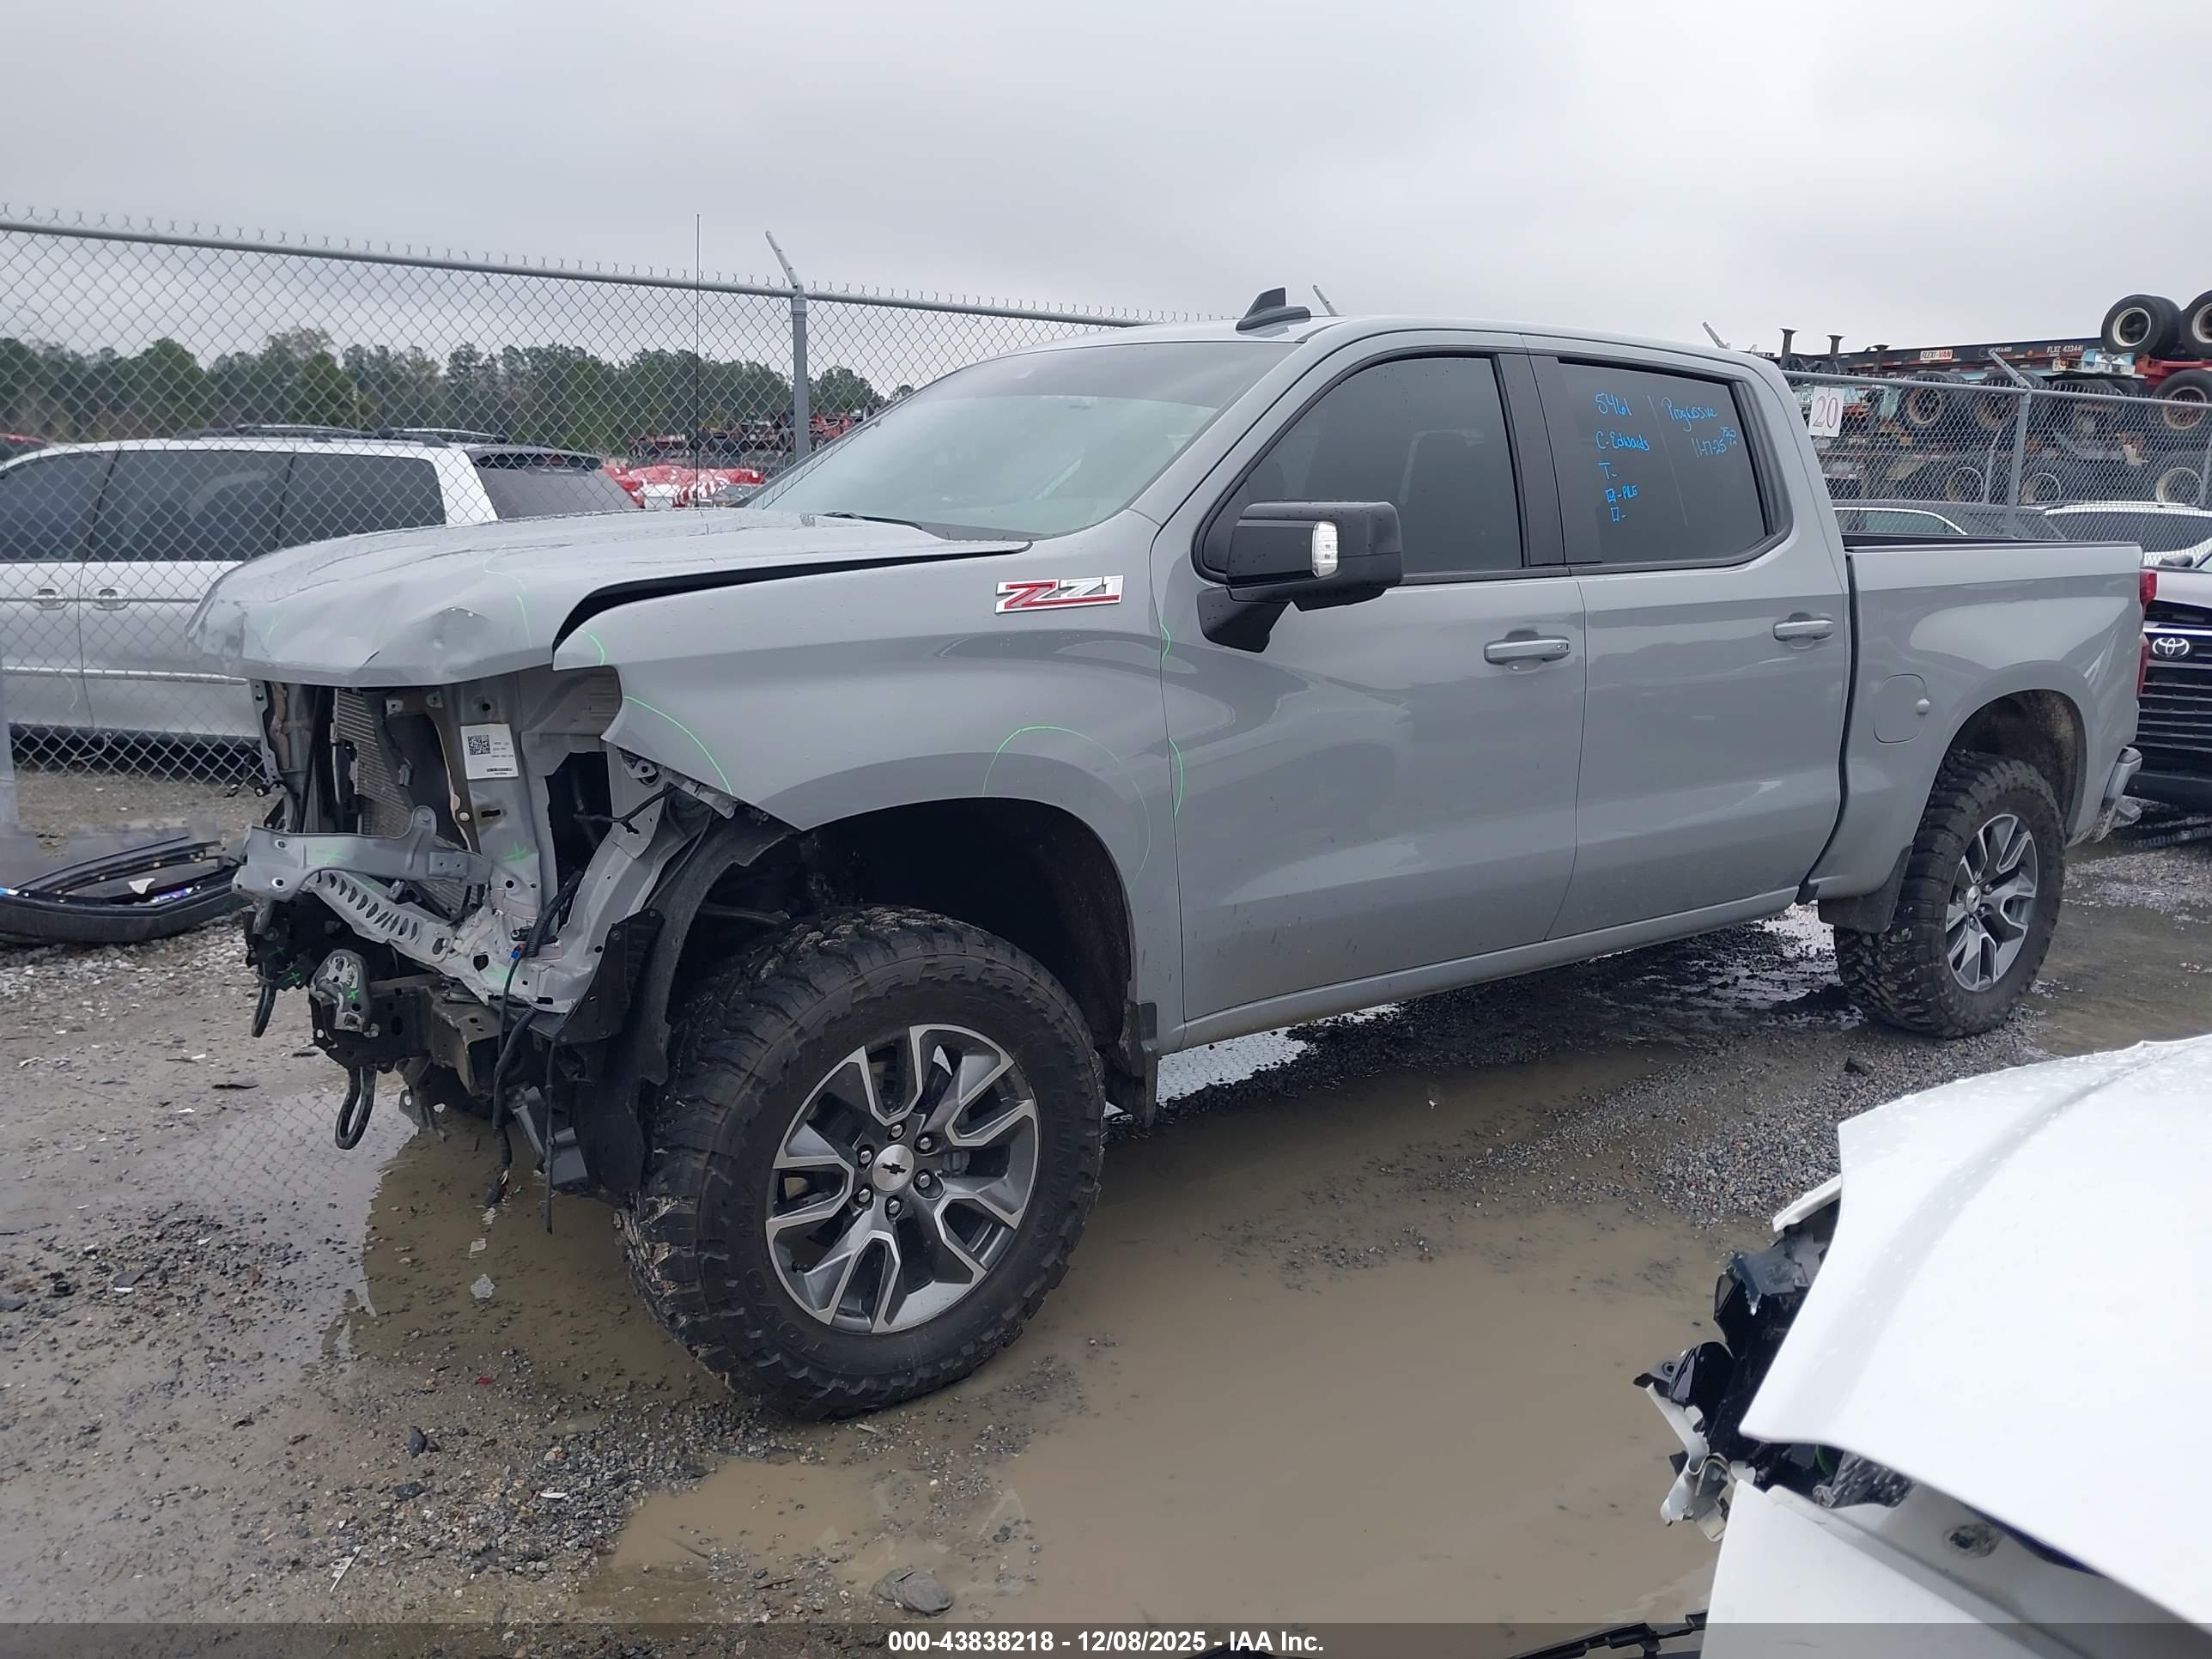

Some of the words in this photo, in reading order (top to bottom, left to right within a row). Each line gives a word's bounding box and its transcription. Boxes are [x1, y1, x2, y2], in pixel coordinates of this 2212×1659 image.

[1595, 392, 1632, 416] 5461
[1813, 396, 1839, 429] 20
[994, 574, 1123, 615] Z71
